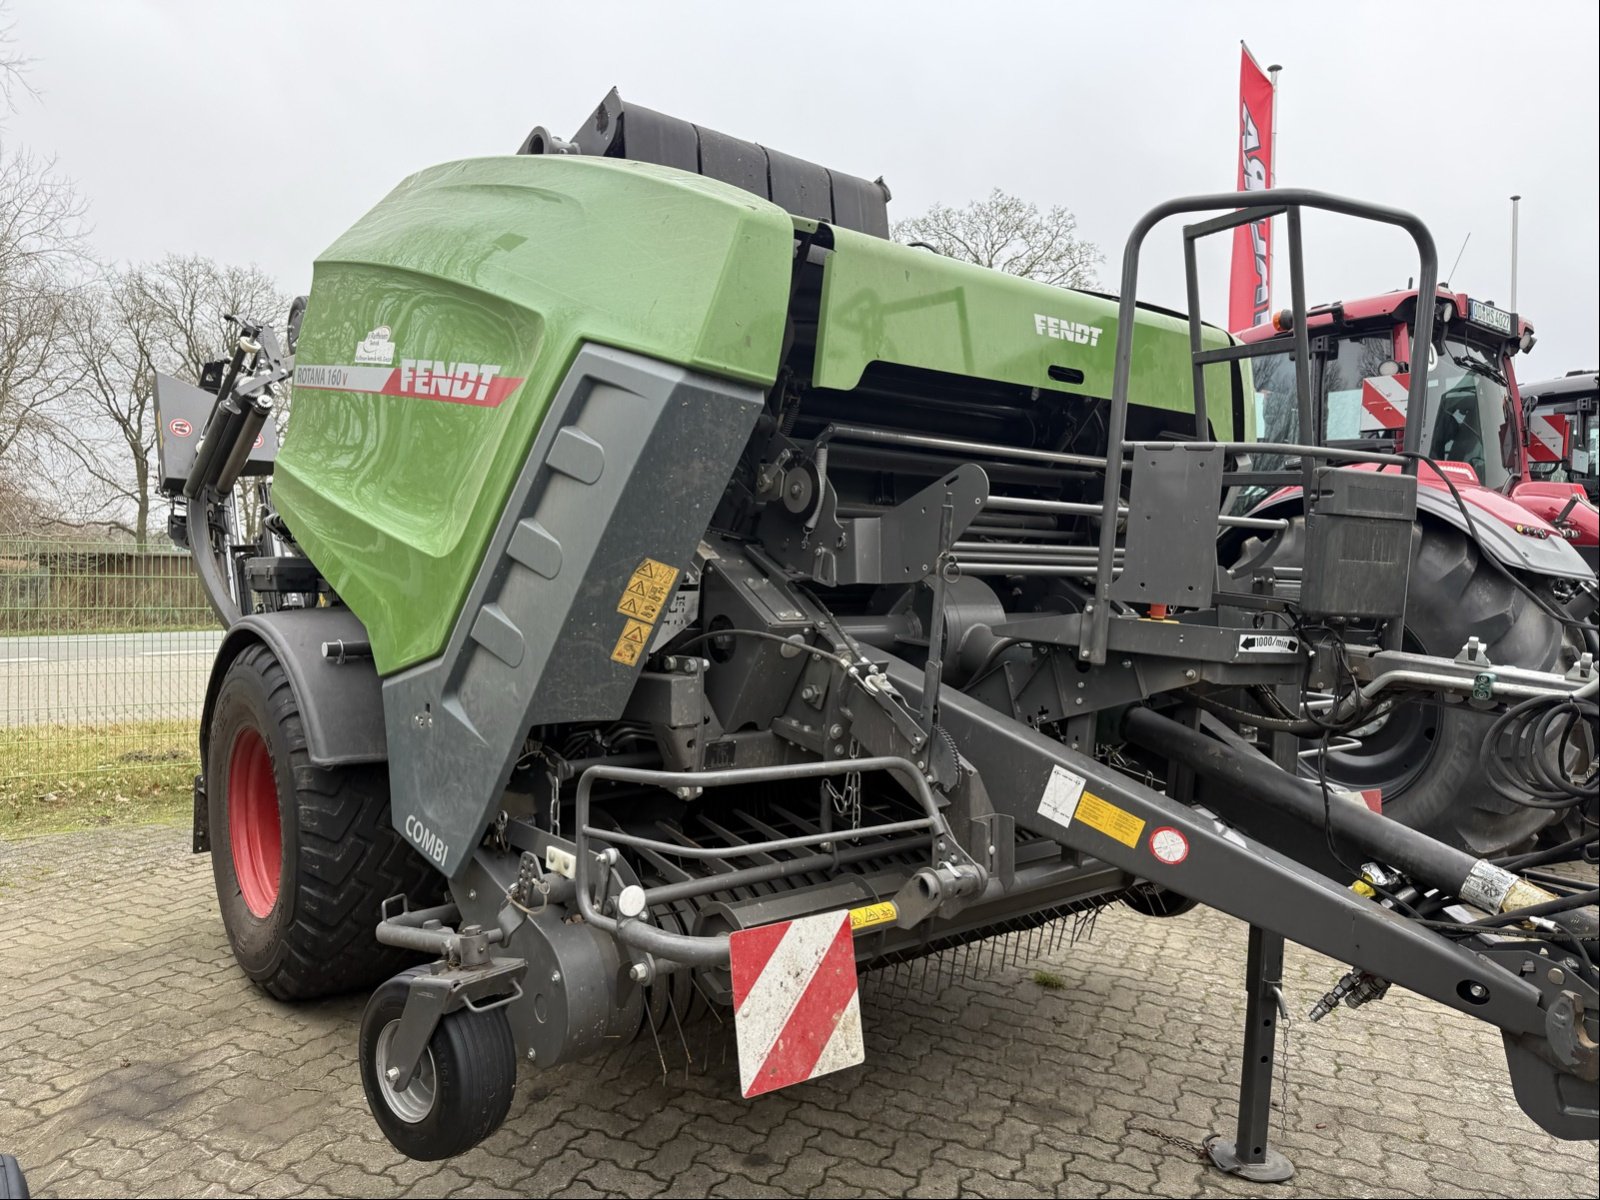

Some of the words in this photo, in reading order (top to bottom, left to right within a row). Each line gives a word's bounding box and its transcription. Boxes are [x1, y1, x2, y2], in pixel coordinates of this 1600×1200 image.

[1034, 313, 1103, 347] FENDT
[297, 367, 325, 385] ROTANA
[328, 368, 342, 386] 160
[400, 358, 501, 401] FENDT
[1256, 635, 1288, 649] 1000/min
[405, 814, 449, 867] COMBI
